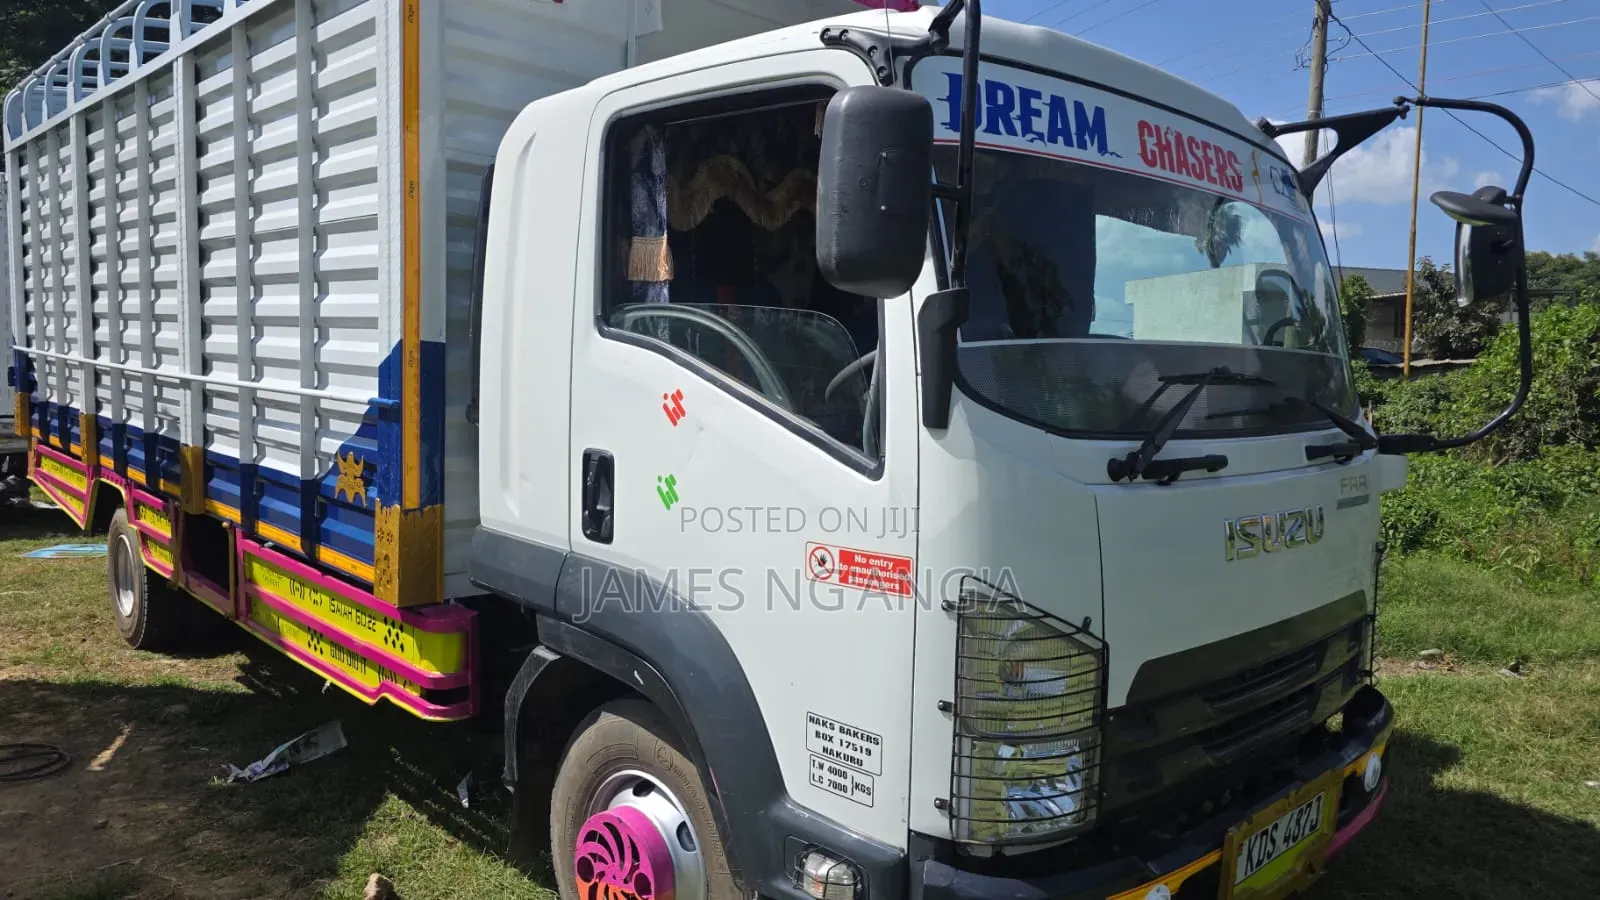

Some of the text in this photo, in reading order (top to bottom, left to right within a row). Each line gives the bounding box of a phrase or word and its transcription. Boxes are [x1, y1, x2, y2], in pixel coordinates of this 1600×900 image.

[937, 72, 1243, 193] DREAM CHASERS
[1224, 504, 1325, 562] ISUZU
[854, 554, 894, 570] No entry
[815, 730, 872, 757] BOX 17519
[839, 725, 880, 746] BAKERS
[822, 745, 863, 767] NAKURU
[827, 765, 848, 780] 4000
[828, 779, 848, 794] 7000
[854, 782, 872, 797] KGS
[1244, 822, 1279, 877] KDS
